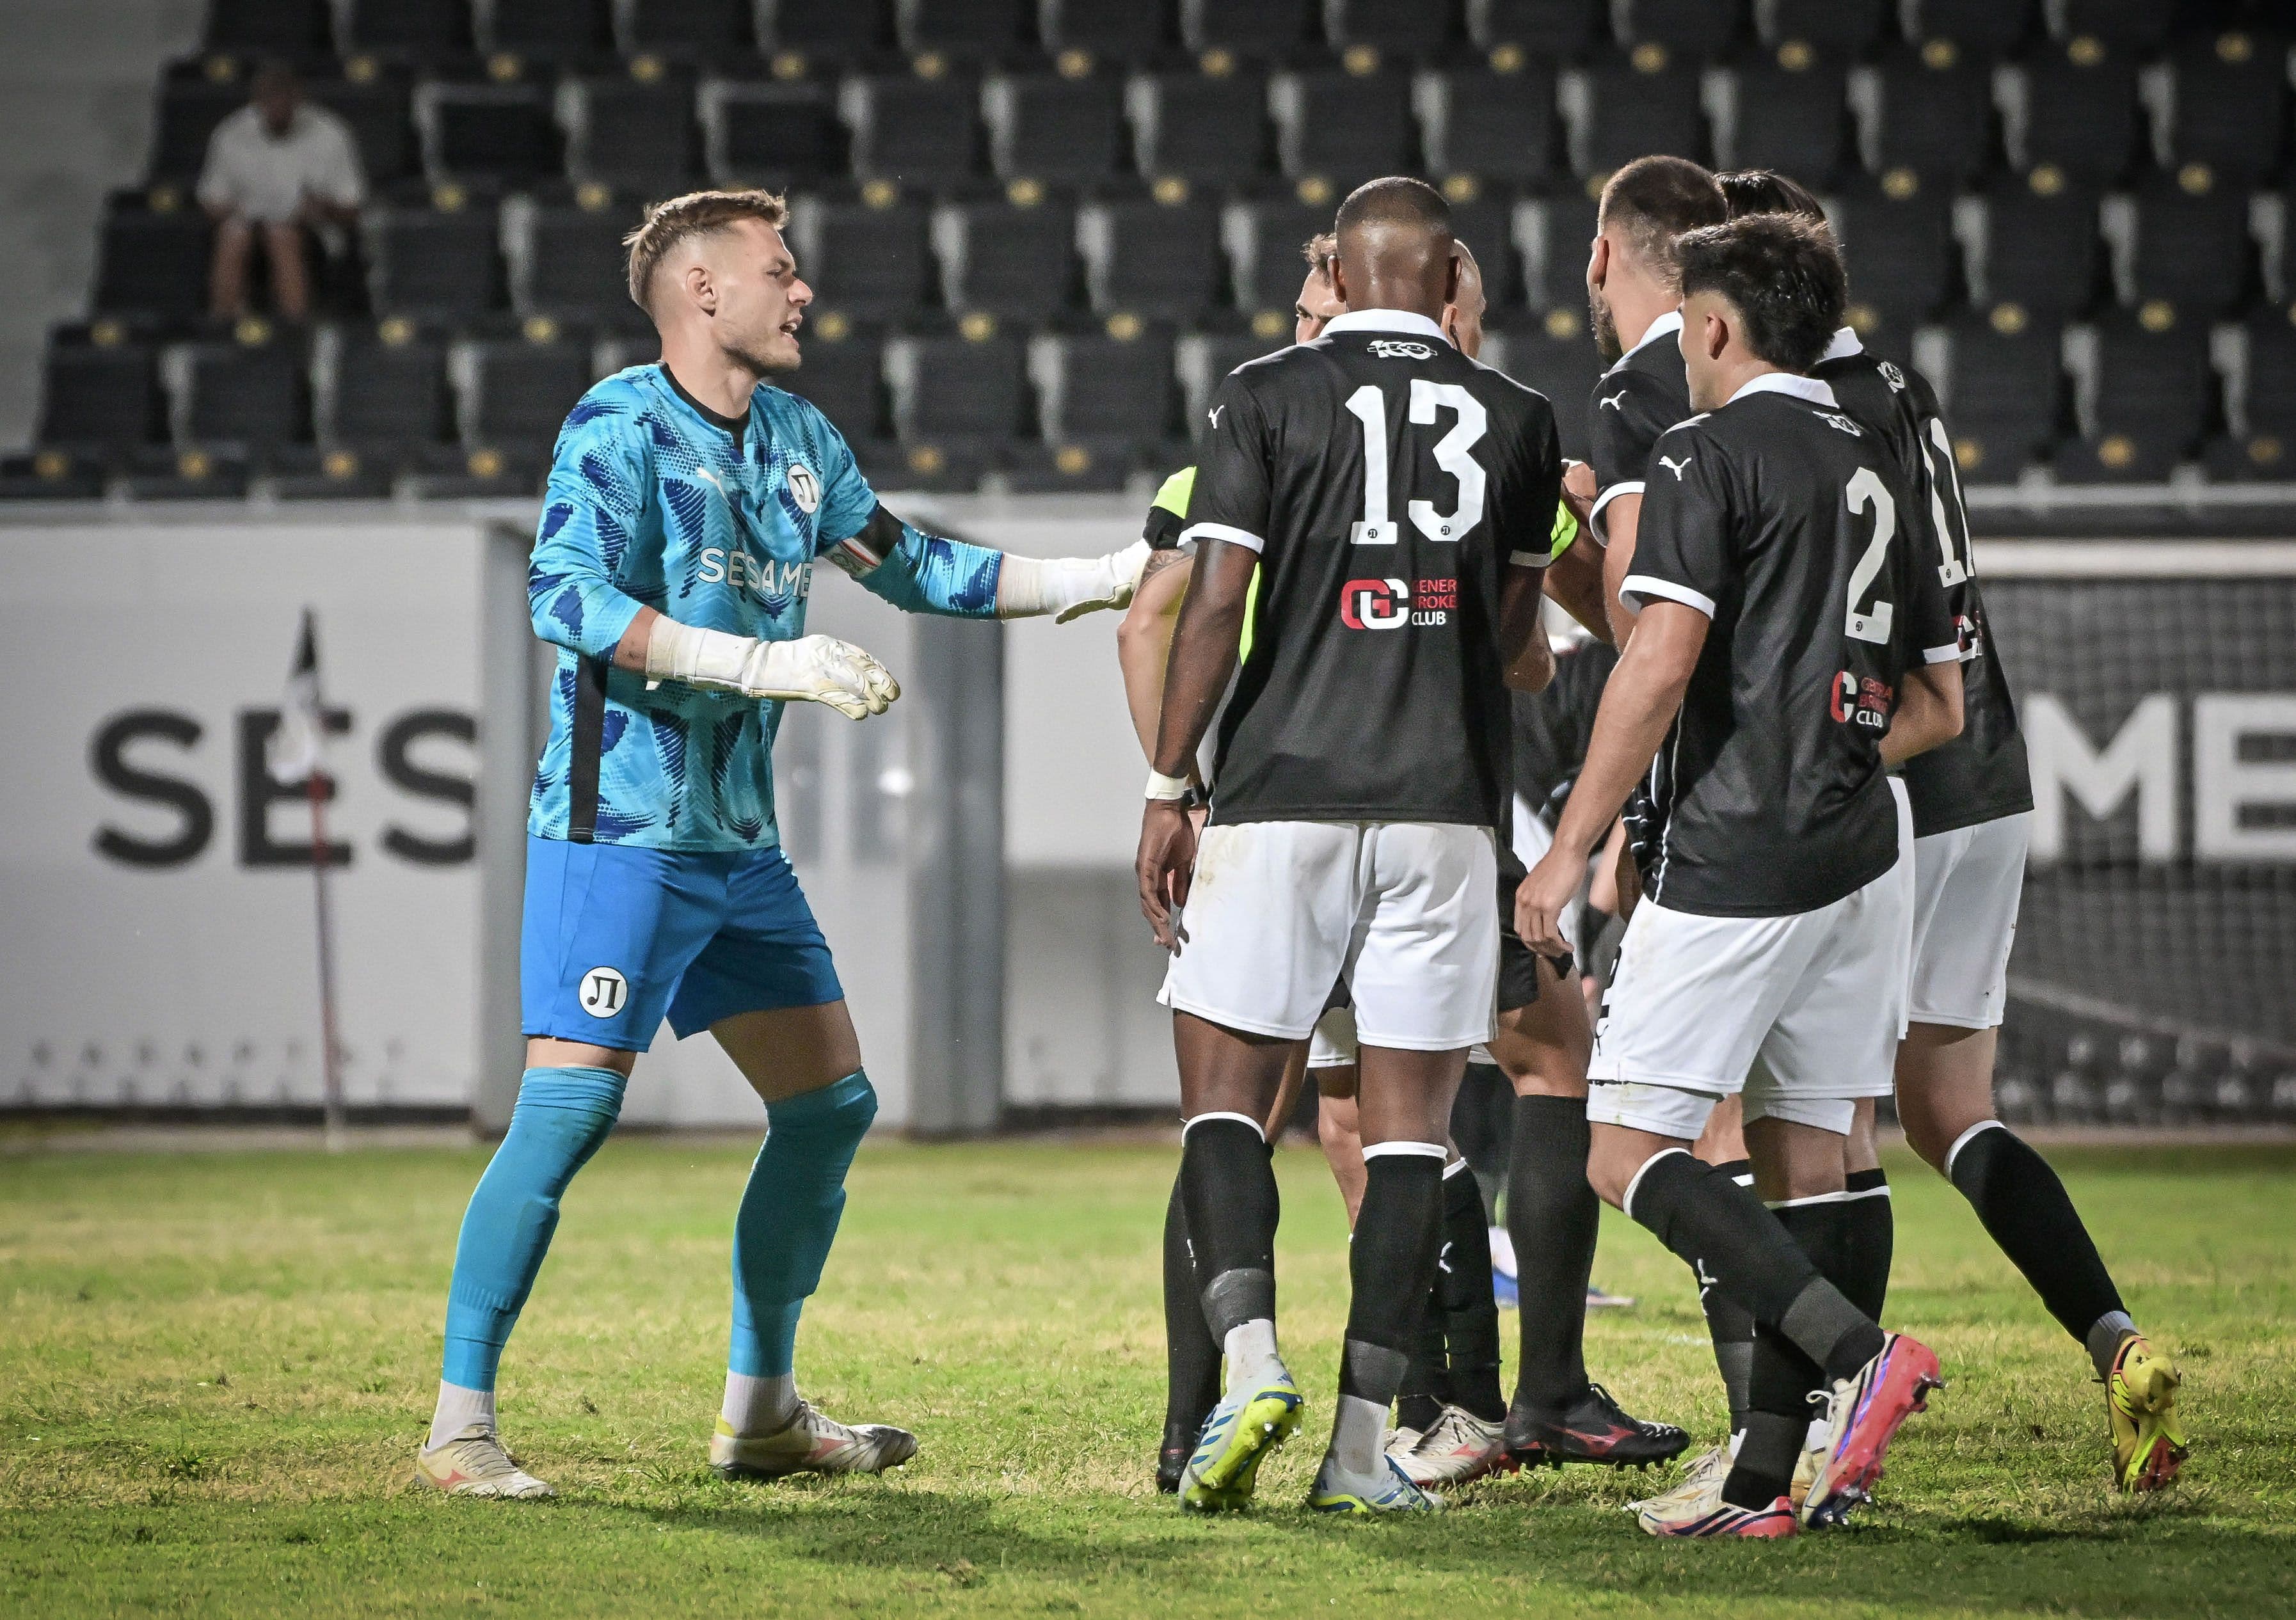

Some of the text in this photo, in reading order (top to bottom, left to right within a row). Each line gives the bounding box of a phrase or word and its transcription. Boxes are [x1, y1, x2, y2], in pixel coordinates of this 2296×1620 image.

[1344, 379, 1487, 544] 13
[698, 548, 813, 597] SESAME
[1845, 466, 1894, 644] 2
[1412, 611, 1446, 626] CLUB
